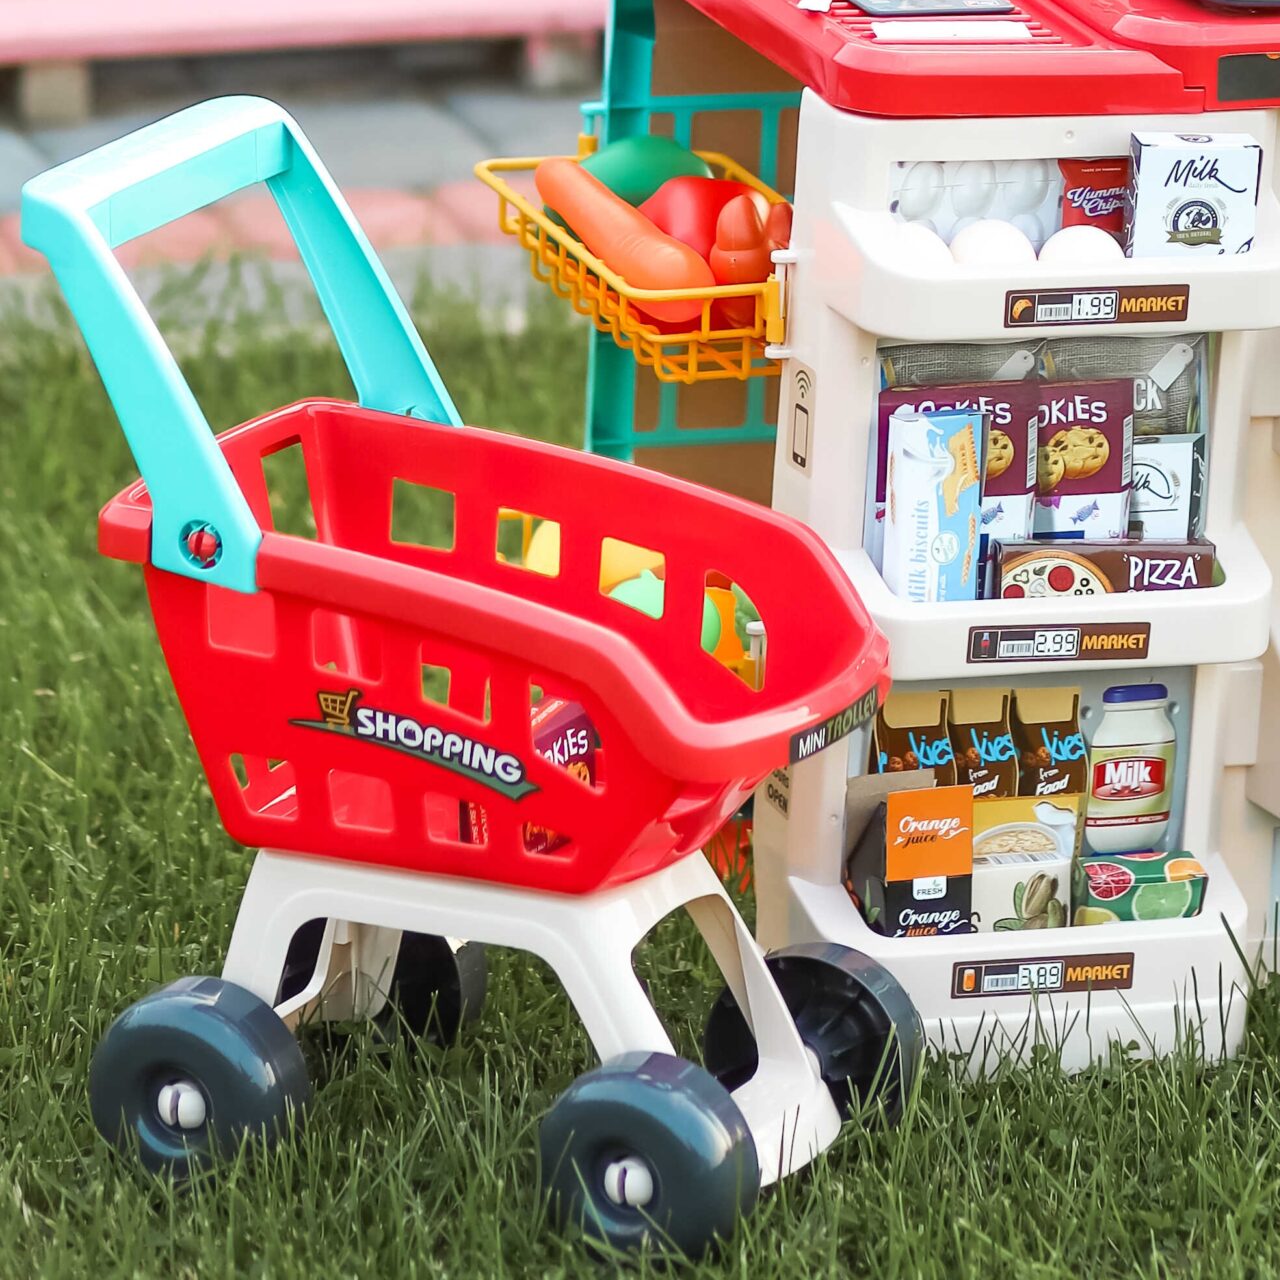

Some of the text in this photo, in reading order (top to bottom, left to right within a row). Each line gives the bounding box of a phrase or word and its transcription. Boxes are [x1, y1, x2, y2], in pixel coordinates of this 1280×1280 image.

[1164, 155, 1247, 193] Milk
[1077, 296, 1185, 316] 1.99 MARKET
[1130, 472, 1173, 500] ilk
[909, 499, 930, 563] biscuits
[1035, 633, 1147, 653] 2.99 MARKET
[799, 687, 877, 759] MINI TROLLEY
[356, 707, 522, 784] SHOPPING
[969, 768, 989, 782] from
[1036, 773, 1070, 796] Food
[1039, 767, 1059, 781] from
[1104, 760, 1152, 790] Milk
[767, 783, 788, 814] OPEN
[899, 816, 969, 839] Orange
[903, 833, 938, 849] juice
[917, 888, 943, 896] FRESH
[899, 908, 969, 932] Orange
[1066, 964, 1131, 982] MARKET
